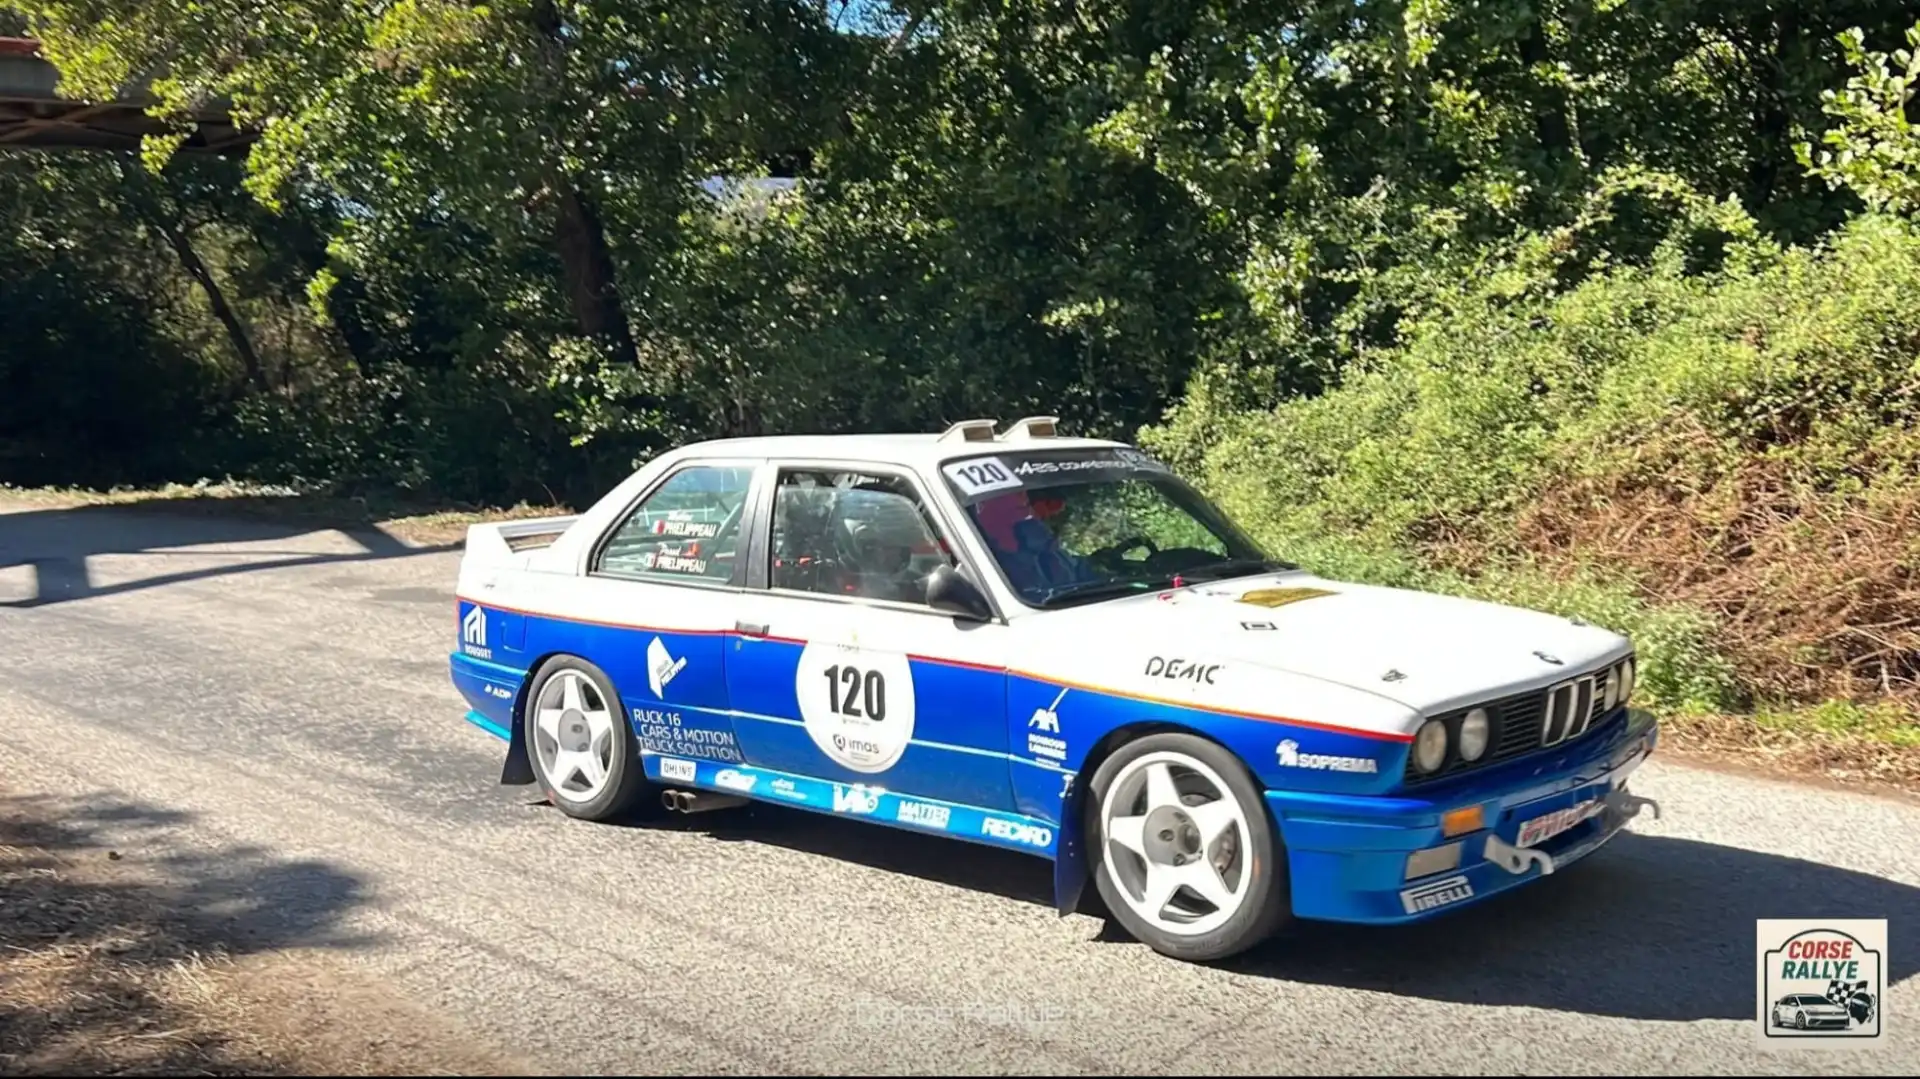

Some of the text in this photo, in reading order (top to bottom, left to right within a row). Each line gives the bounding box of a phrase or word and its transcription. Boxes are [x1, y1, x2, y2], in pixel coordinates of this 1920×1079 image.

[958, 462, 1008, 487] 120
[824, 664, 886, 721] 120
[666, 712, 682, 727] 16
[640, 723, 735, 746] CARS & MOTION
[848, 735, 880, 754] imas
[636, 735, 742, 761] TRUCK SOLUTION
[1297, 753, 1378, 774] SOPREMA
[982, 817, 1053, 847] RECARO
[1400, 875, 1475, 915] PIRELLI
